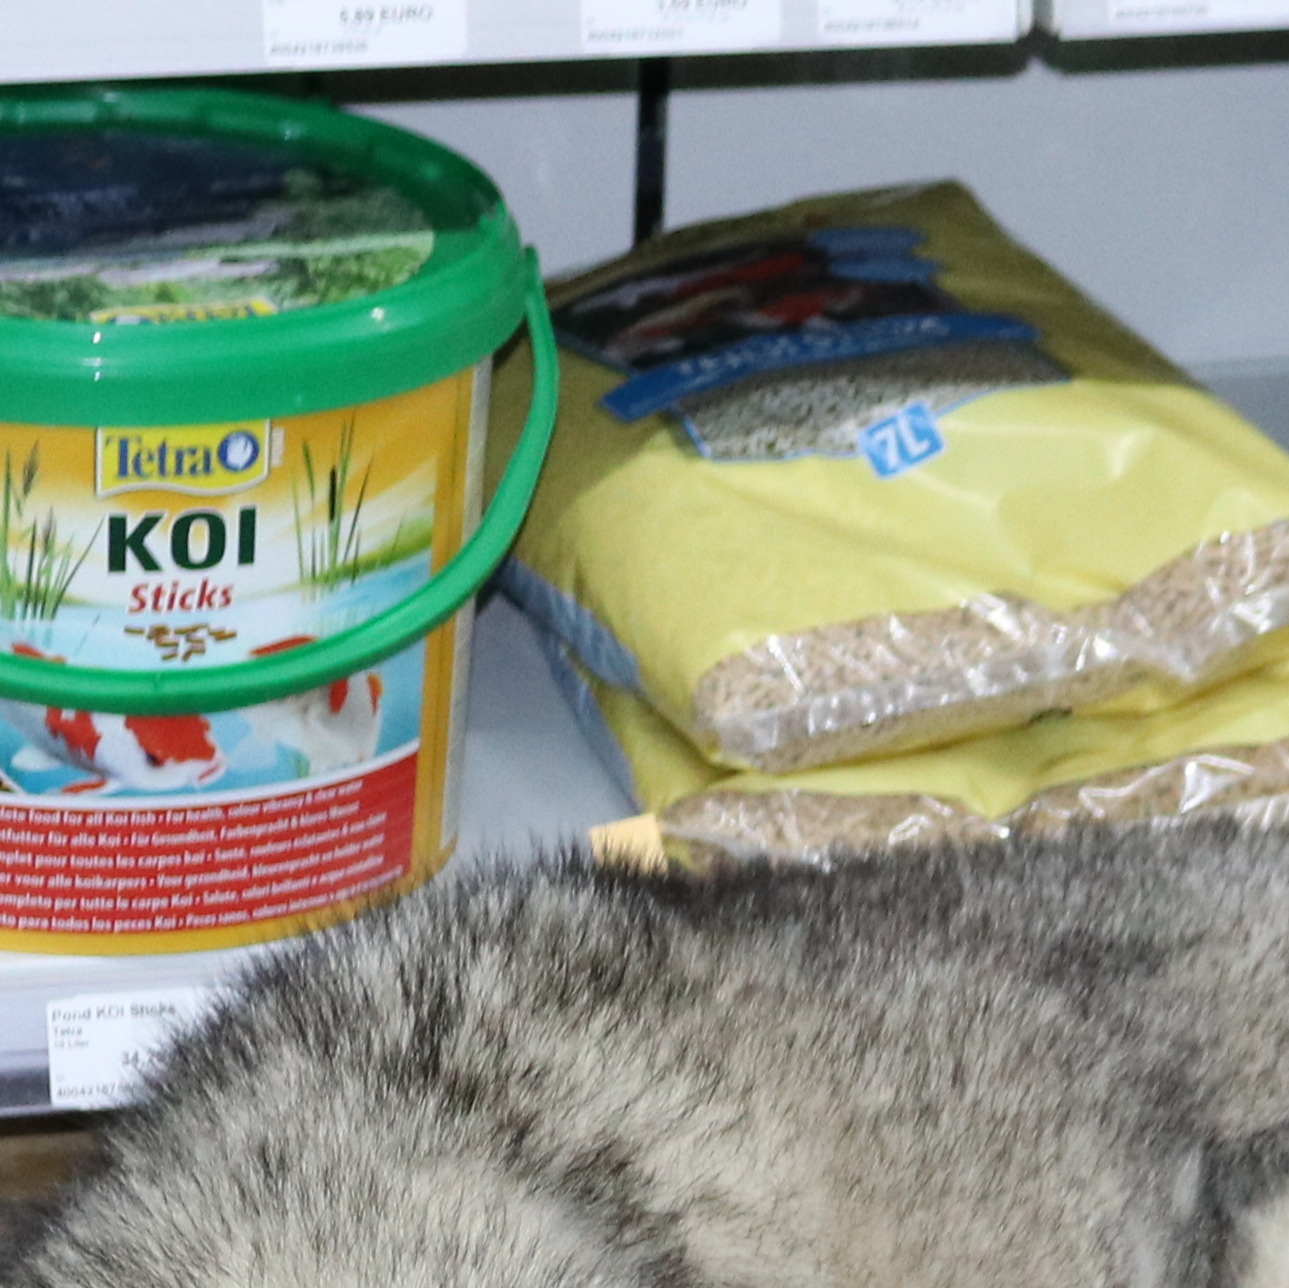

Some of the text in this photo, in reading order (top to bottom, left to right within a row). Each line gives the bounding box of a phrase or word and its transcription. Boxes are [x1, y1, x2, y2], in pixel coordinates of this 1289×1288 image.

[106, 434, 213, 478] Tetra
[107, 507, 257, 574] KOI
[128, 577, 234, 615] Sticks
[29, 811, 60, 825] food
[63, 811, 83, 825] for
[85, 812, 103, 826] all
[106, 812, 129, 826] Koi
[130, 810, 156, 826] fish
[48, 831, 67, 847] für
[70, 832, 95, 848] alle
[98, 833, 121, 848] Koi
[35, 854, 67, 870] pour
[70, 854, 114, 868] toutes
[116, 854, 135, 868] les
[138, 853, 181, 871] carpes
[15, 871, 44, 887] voor
[48, 872, 72, 888] alle
[54, 896, 77, 912] per
[131, 895, 169, 912] carpe
[171, 892, 193, 908] Koi
[18, 913, 49, 932] para
[51, 914, 89, 932] todos
[92, 915, 111, 931] los
[113, 915, 153, 934] peces
[154, 914, 177, 930] Koi
[52, 1007, 92, 1022] Pond
